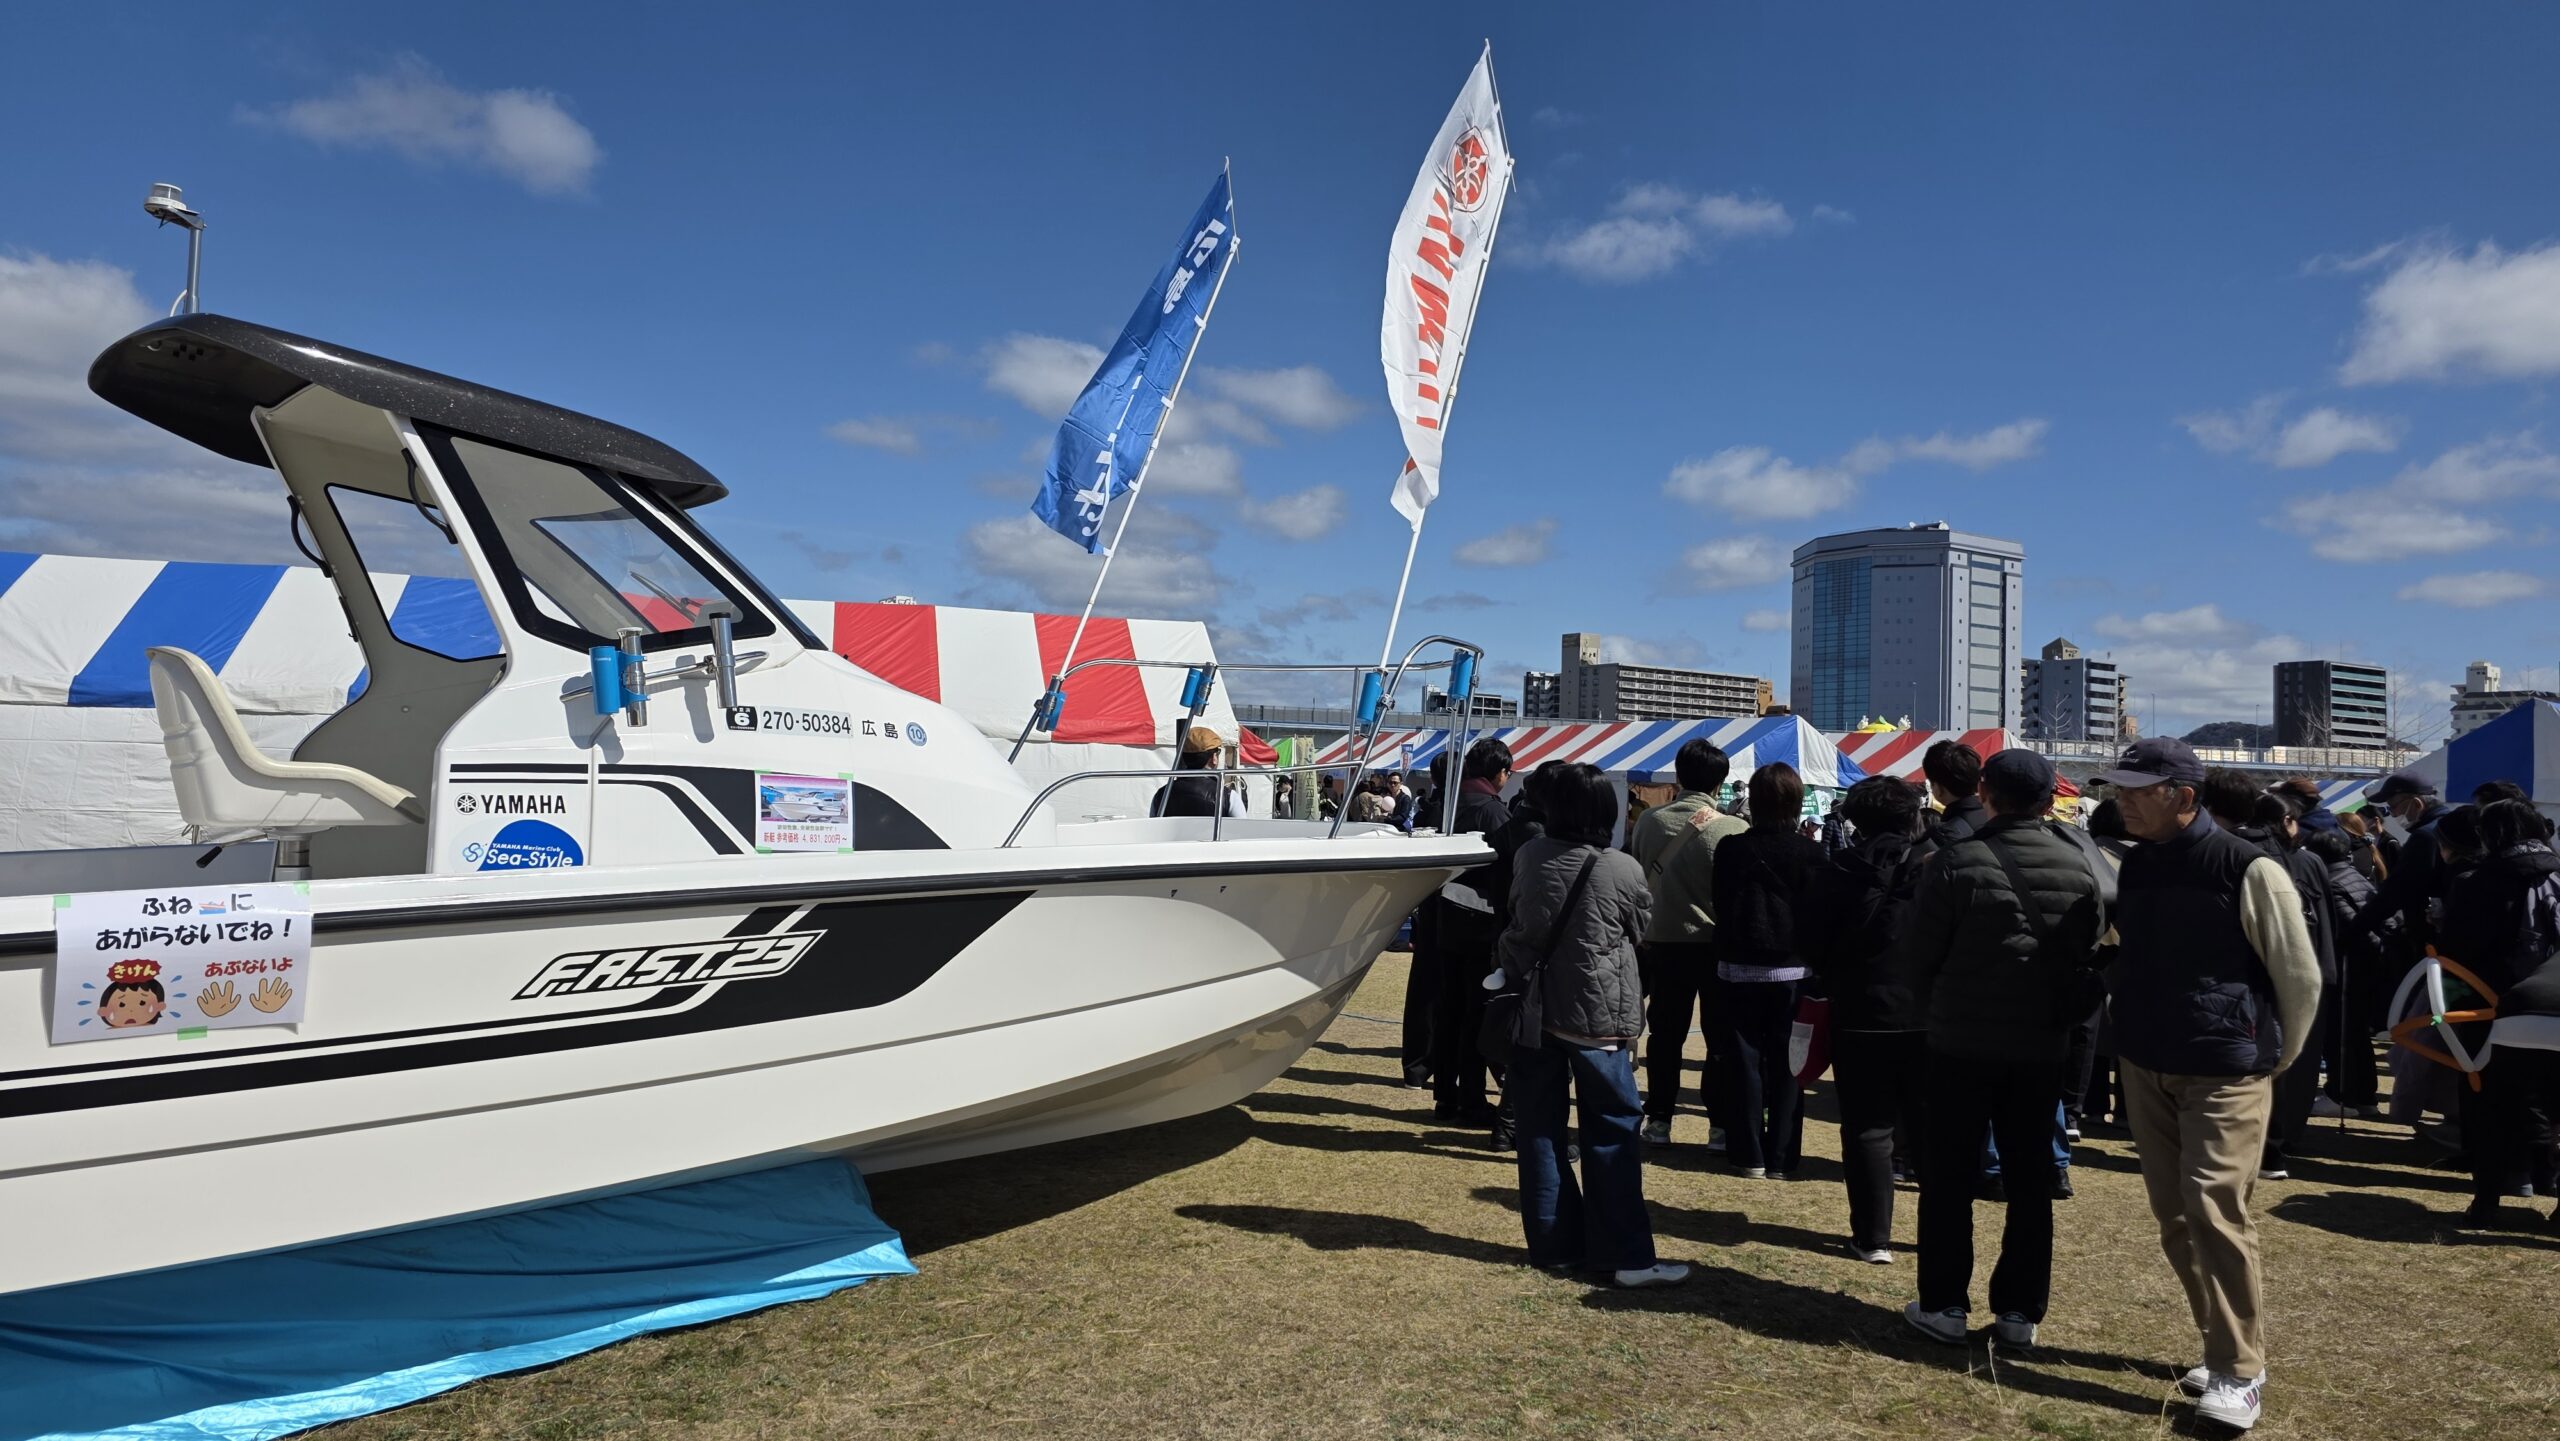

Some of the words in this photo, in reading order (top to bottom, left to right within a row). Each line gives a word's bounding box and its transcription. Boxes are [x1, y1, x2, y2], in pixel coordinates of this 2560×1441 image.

[734, 712, 750, 726] 6
[910, 728, 922, 740] 10
[481, 795, 566, 814] YAMAHA
[486, 849, 573, 868] Sea-Style
[141, 896, 193, 916] ふね
[231, 893, 255, 911] に
[112, 964, 157, 979] きけん
[204, 957, 294, 978] あぶないよ
